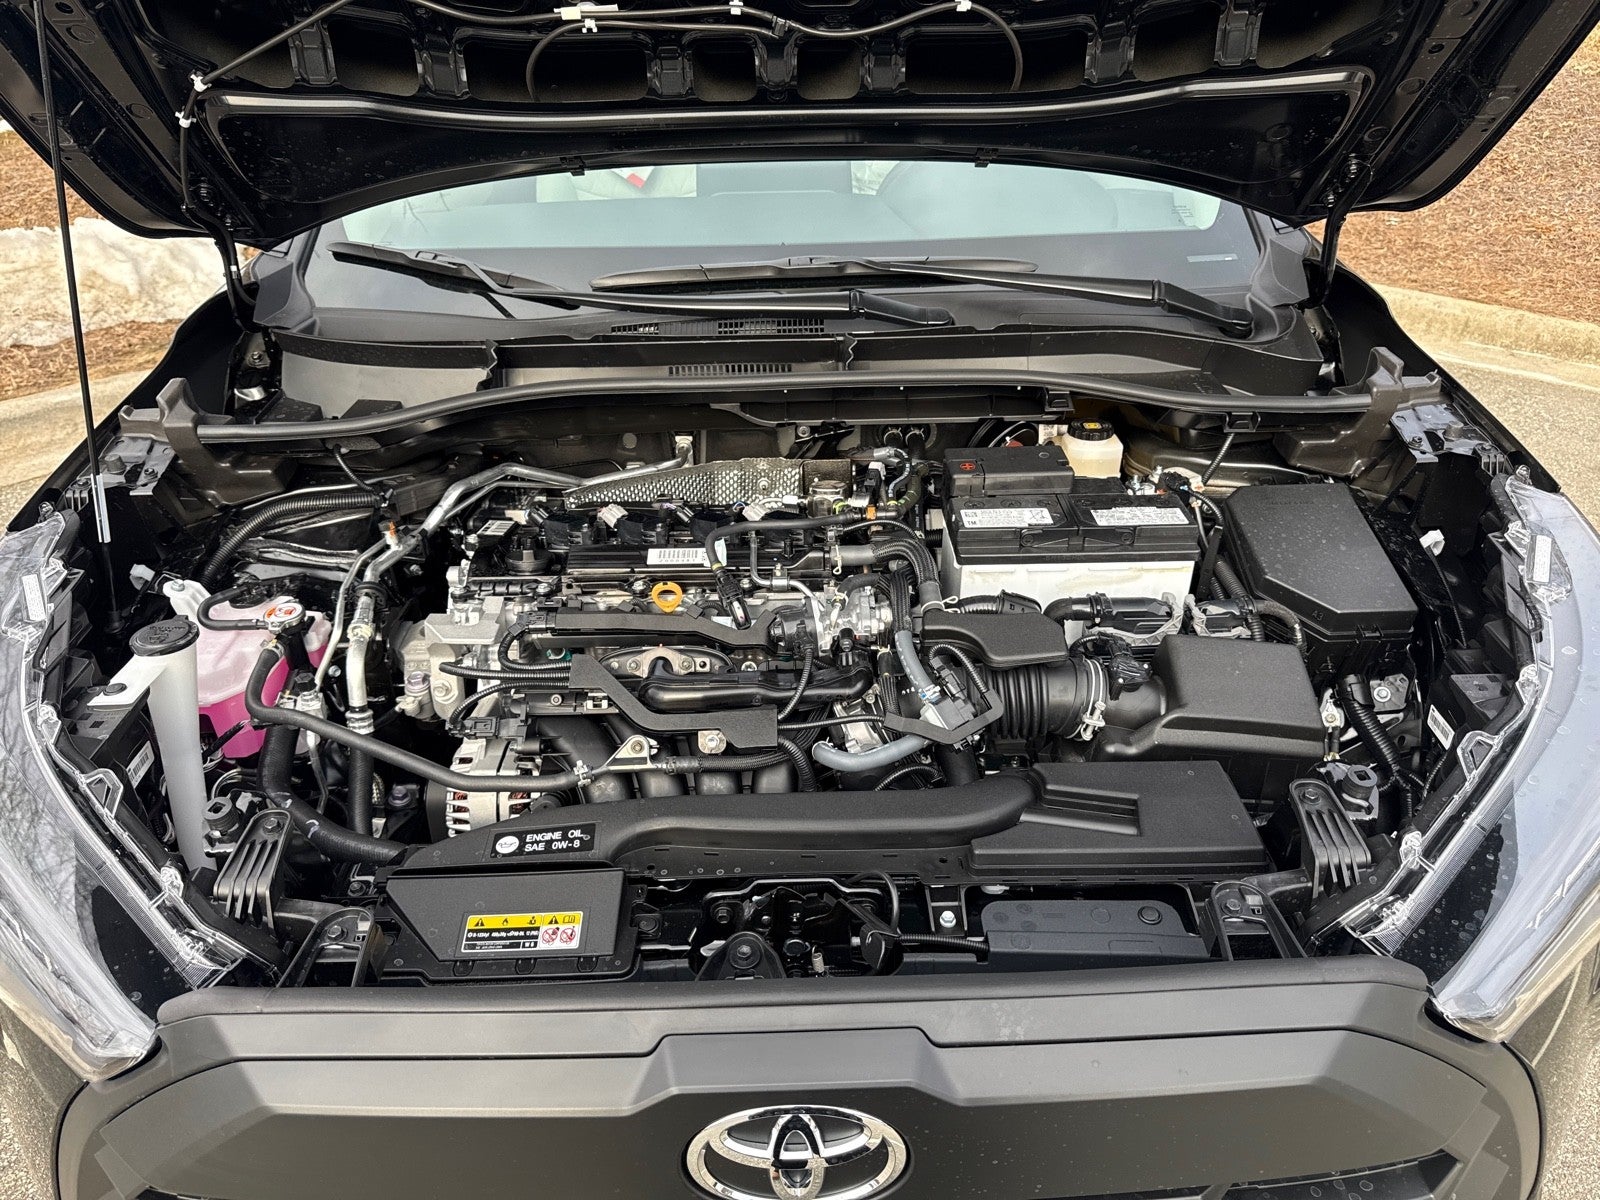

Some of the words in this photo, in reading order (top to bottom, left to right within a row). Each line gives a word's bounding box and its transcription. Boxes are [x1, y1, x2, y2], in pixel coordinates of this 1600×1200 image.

[525, 831, 562, 842] ENGINE
[568, 829, 584, 838] OIL
[524, 842, 545, 852] SAE
[551, 839, 580, 850] 0W-8
